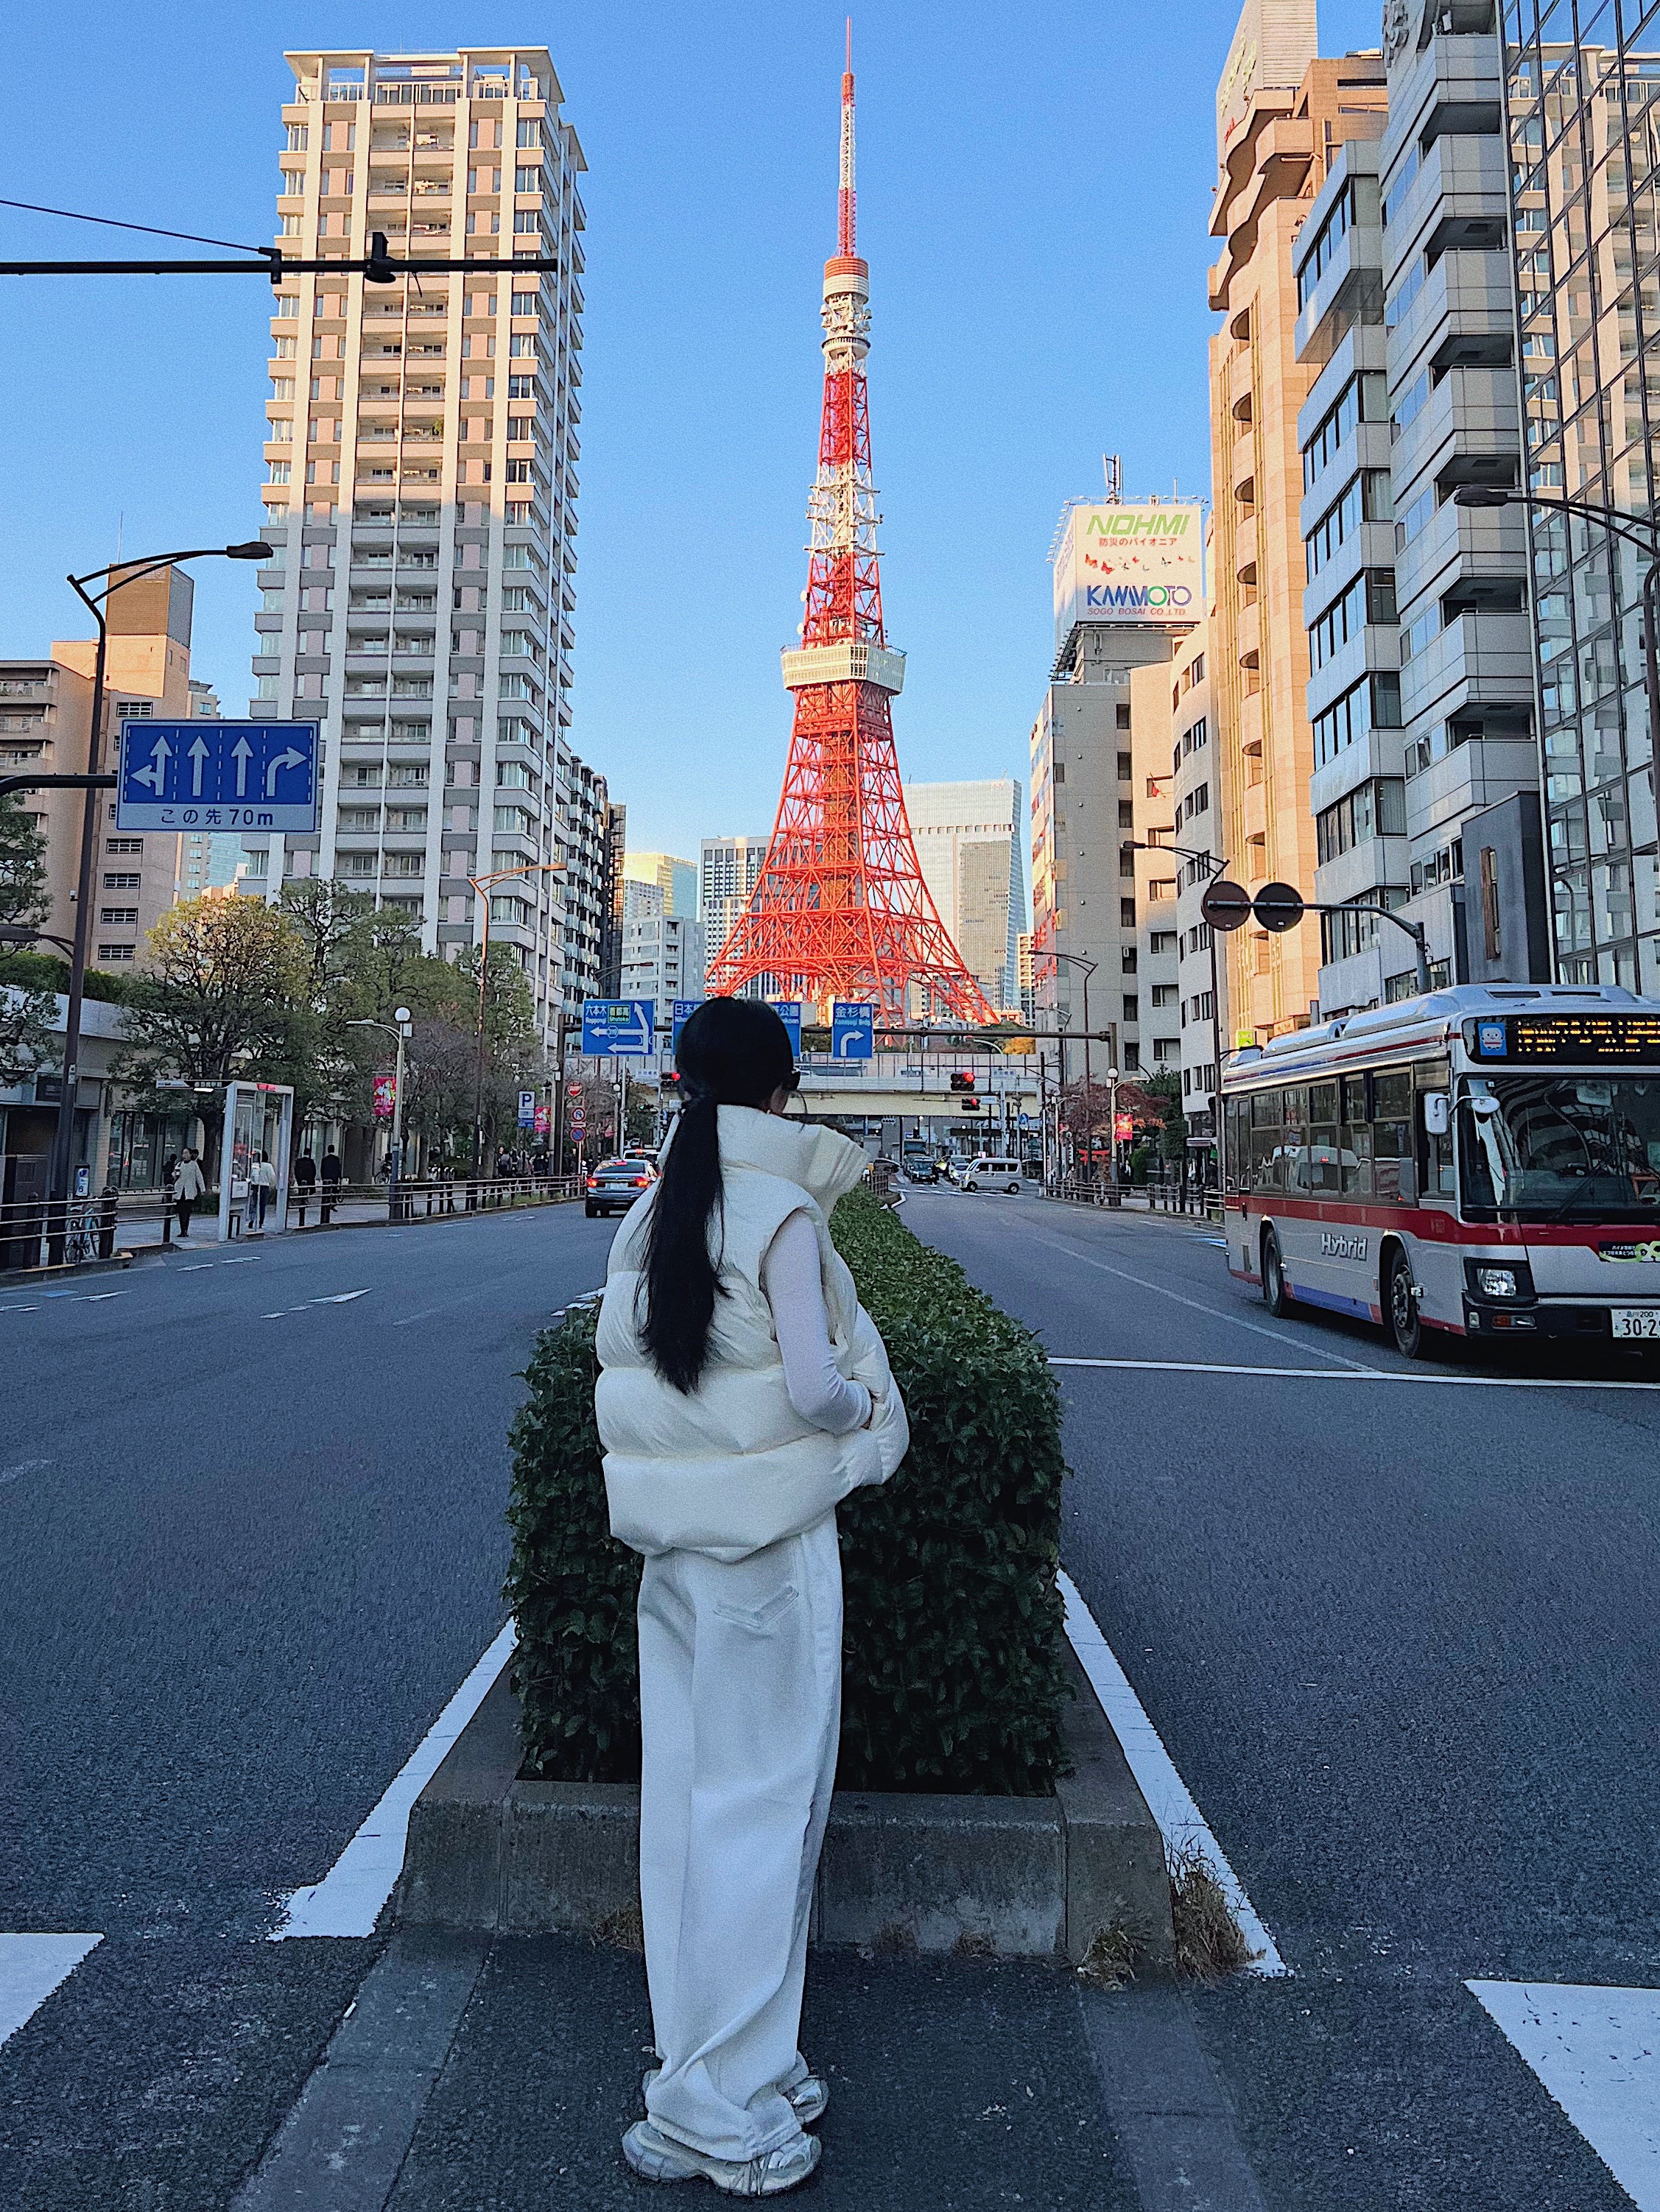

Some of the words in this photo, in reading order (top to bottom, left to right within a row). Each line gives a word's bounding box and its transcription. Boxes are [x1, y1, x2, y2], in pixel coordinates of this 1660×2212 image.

[1086, 514, 1190, 535] NOHMI
[1099, 538, 1178, 546] 防災のパイオニア
[585, 1004, 607, 1017] 六本木
[522, 1093, 532, 1107] P
[1321, 1233, 1368, 1261] Hybrid
[1622, 1318, 1660, 1336] 30-2
